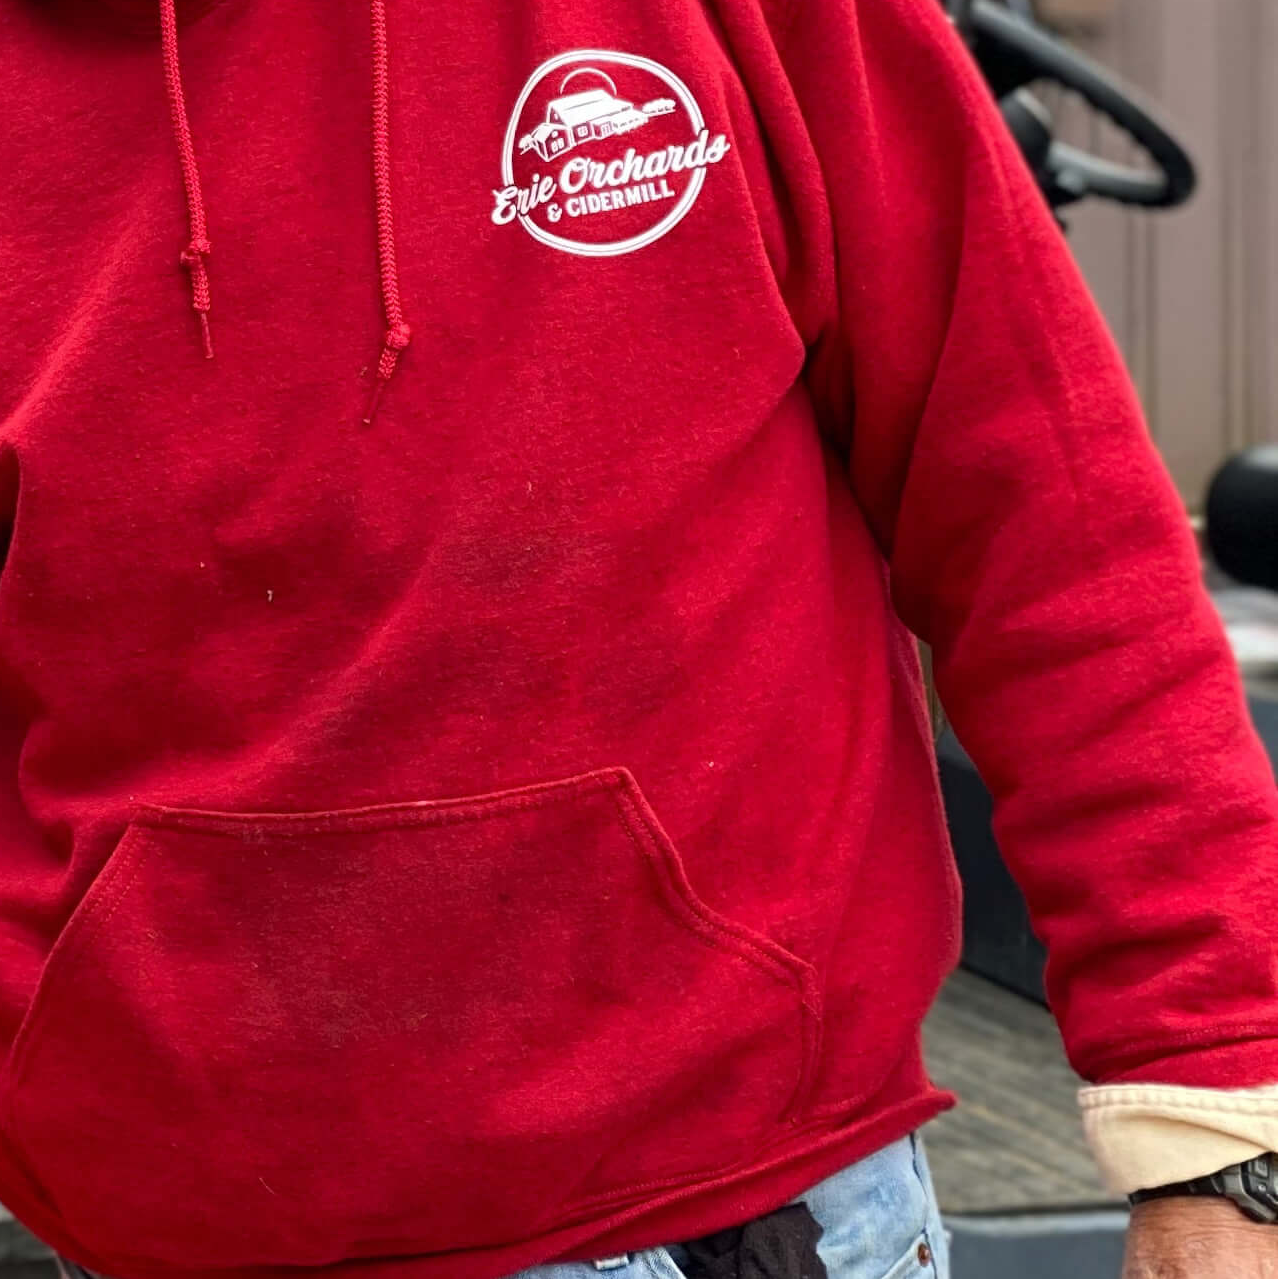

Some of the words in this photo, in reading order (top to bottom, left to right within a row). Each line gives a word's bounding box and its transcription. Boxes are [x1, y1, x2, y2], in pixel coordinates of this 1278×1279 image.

[491, 173, 557, 225] Erie
[559, 129, 731, 194] Orchards
[547, 203, 563, 222] &
[565, 179, 675, 217] CIDERMILL
